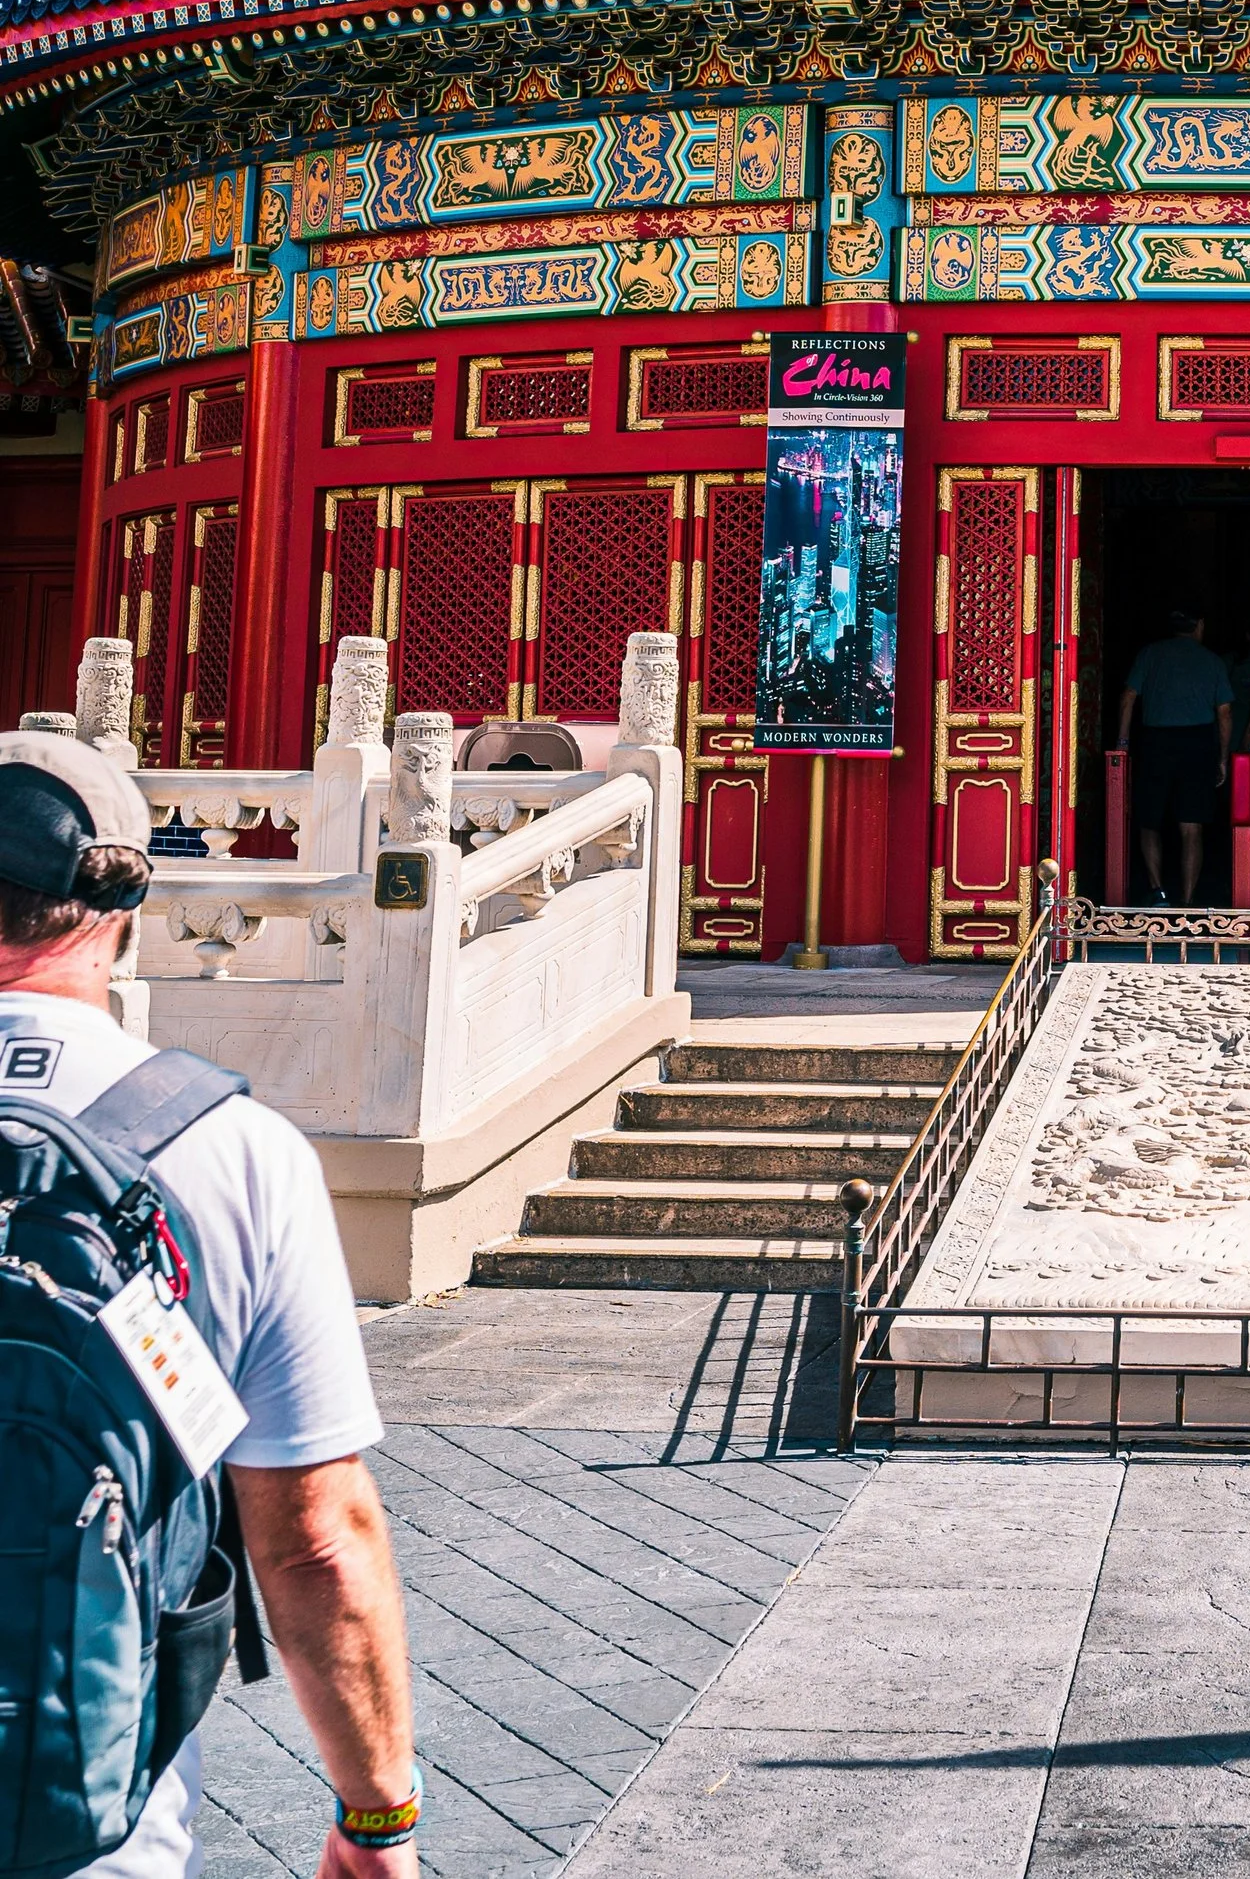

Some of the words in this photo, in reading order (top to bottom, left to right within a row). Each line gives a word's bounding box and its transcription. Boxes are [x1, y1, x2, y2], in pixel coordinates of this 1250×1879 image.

[791, 339, 886, 350] REFLECTIONS
[806, 354, 819, 366] of
[782, 353, 891, 397] China
[813, 392, 822, 401] In
[823, 392, 869, 402] Circle-Vision
[869, 393, 884, 402] 360
[782, 411, 823, 423] Showing
[825, 412, 890, 425] Continuously
[763, 731, 817, 742] MODERN
[822, 732, 884, 744] WONDERS
[5, 1047, 51, 1079] B
